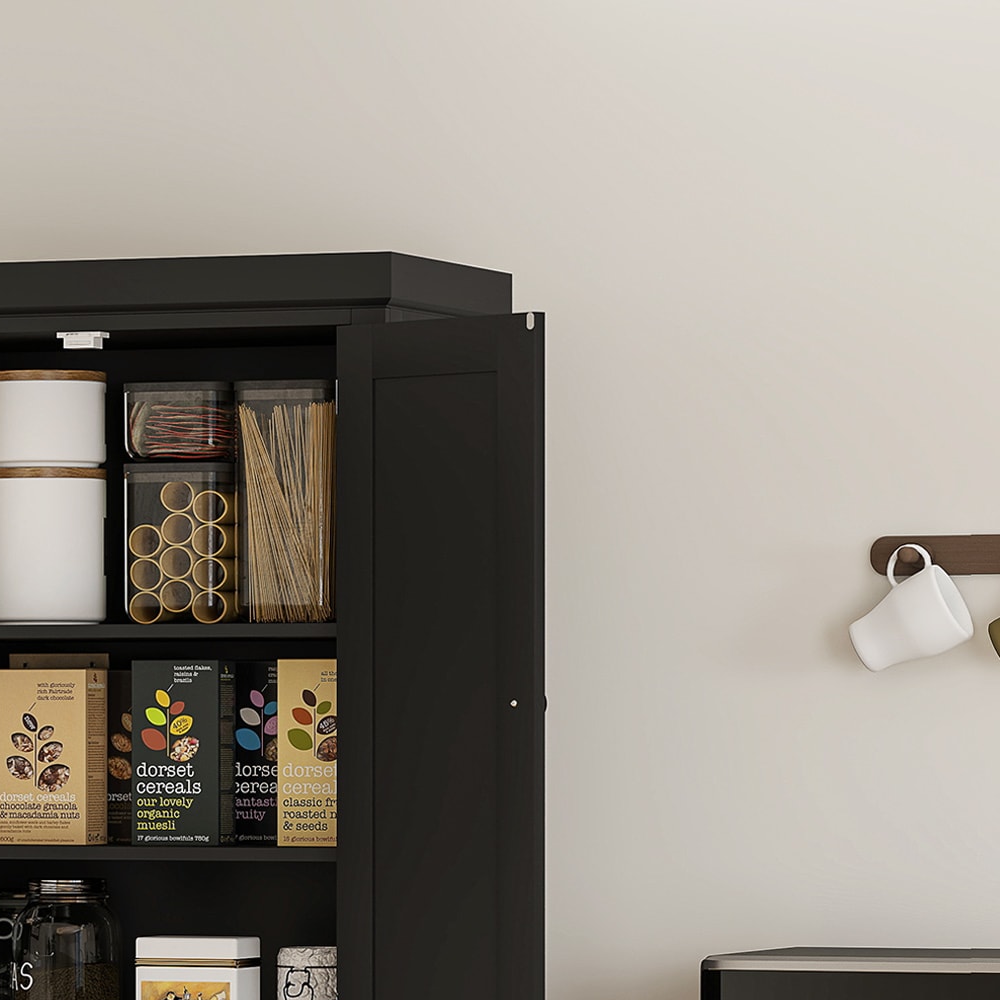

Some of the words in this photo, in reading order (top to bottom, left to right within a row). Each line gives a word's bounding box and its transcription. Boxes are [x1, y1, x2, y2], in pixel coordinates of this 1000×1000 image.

[136, 762, 194, 778] dorset
[136, 780, 202, 794] cereals
[0, 792, 34, 802] dorset
[36, 792, 76, 802] cereals
[136, 798, 158, 807] our
[160, 796, 194, 809] lovely
[282, 797, 322, 808] classic
[0, 802, 42, 810] chocolate
[43, 802, 78, 812] granola
[0, 810, 8, 819] &
[9, 810, 59, 819] macadamia
[60, 811, 80, 820] nuts
[136, 808, 180, 820] organic
[235, 809, 266, 822] ruity
[282, 809, 328, 820] roasted
[136, 820, 176, 830] muesli
[282, 821, 294, 831] &
[296, 821, 328, 831] seeds
